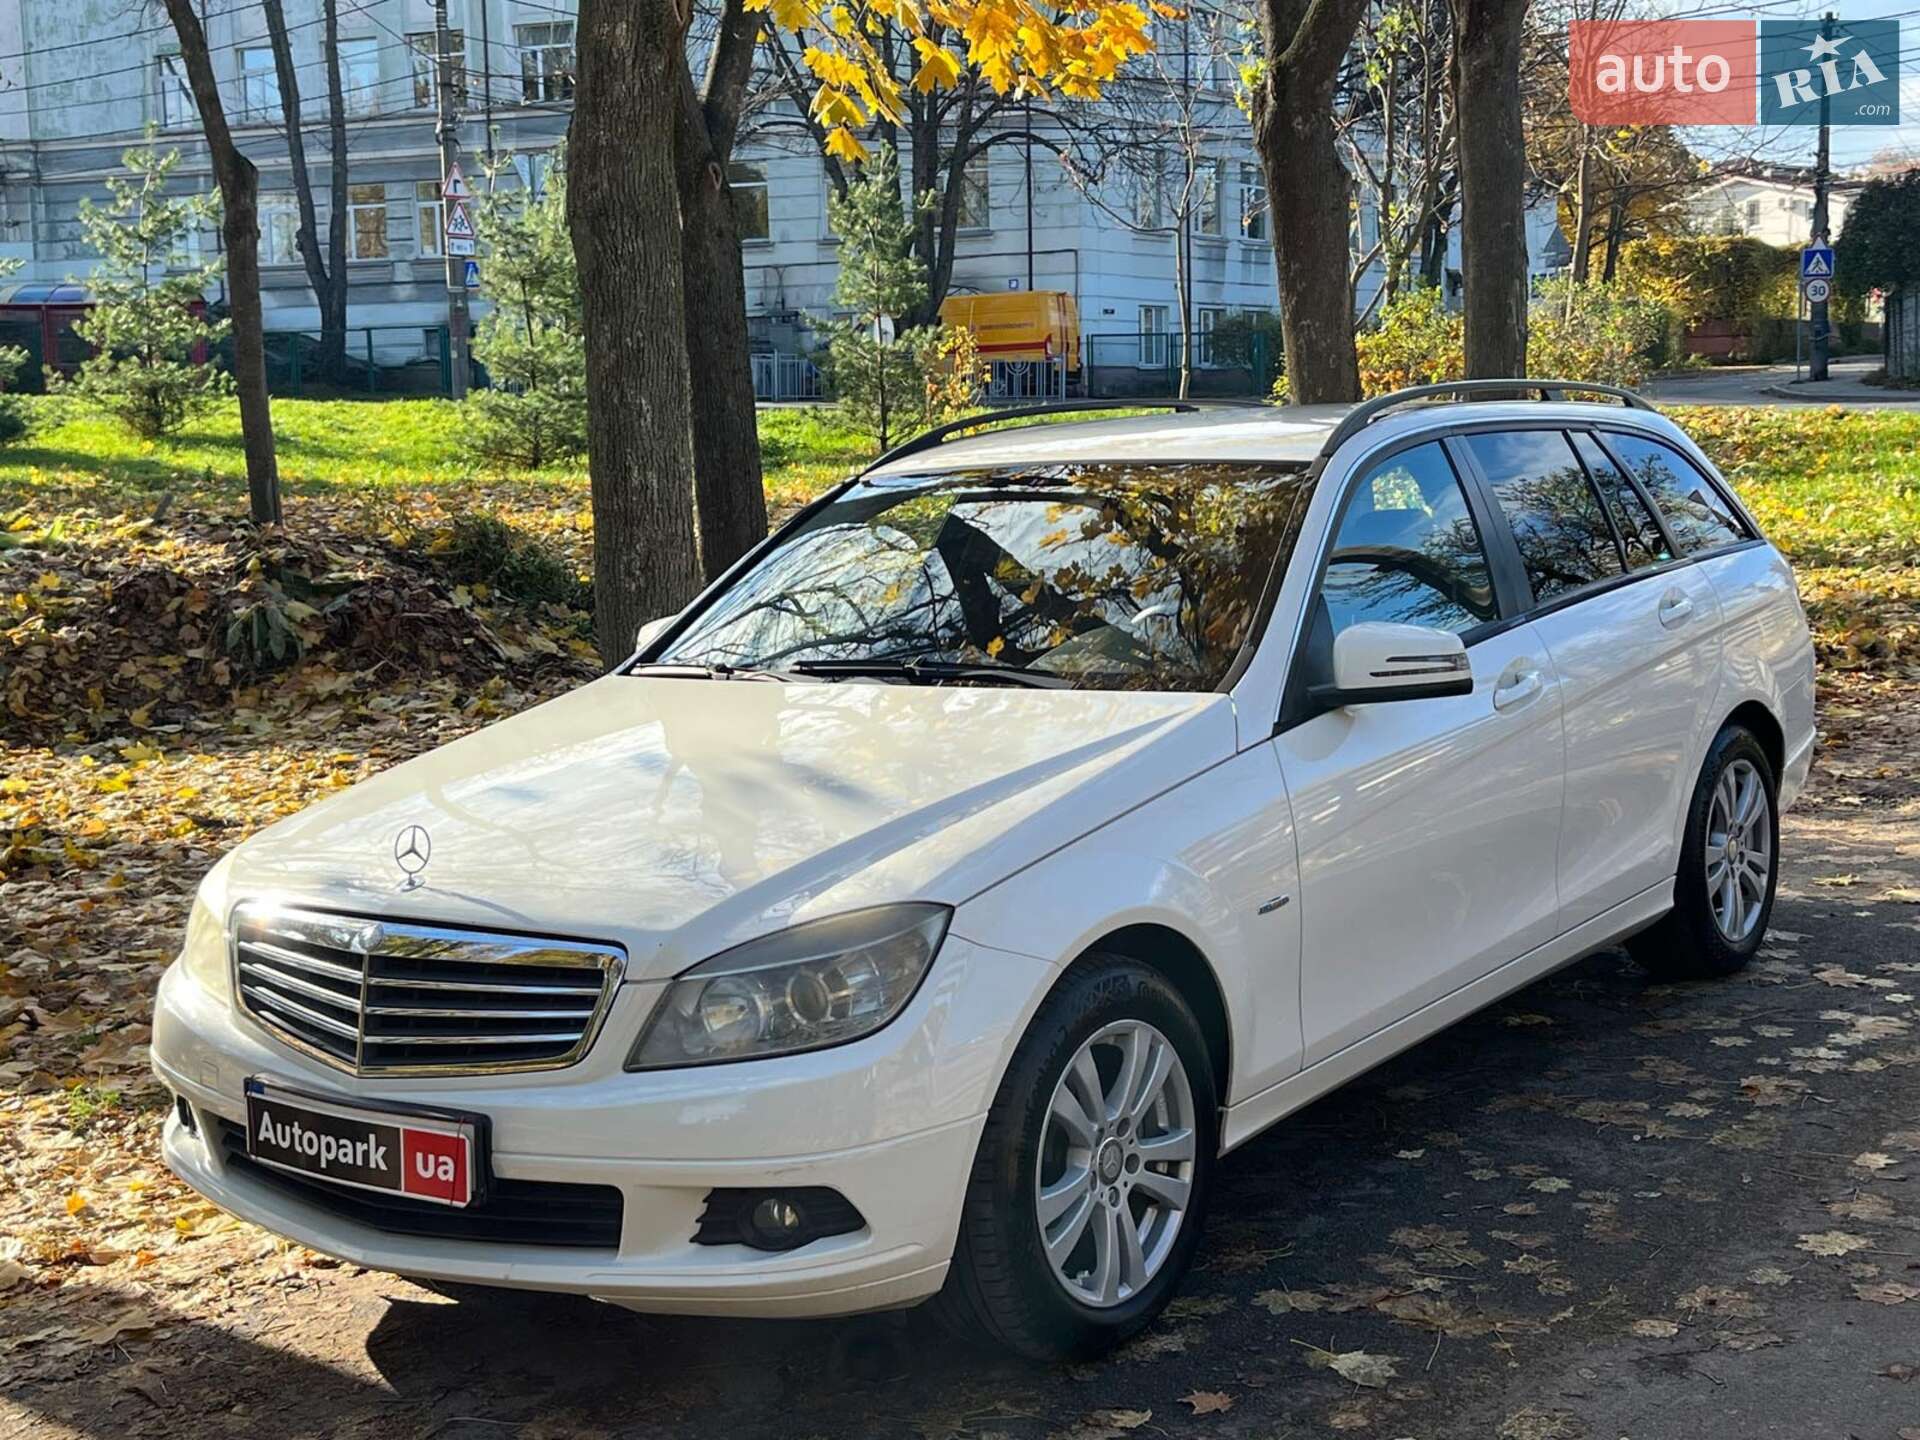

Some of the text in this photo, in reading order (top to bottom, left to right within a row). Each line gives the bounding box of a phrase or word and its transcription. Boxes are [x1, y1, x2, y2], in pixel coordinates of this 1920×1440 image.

[1810, 285, 1826, 297] 30
[258, 1111, 455, 1182] Autopark ua
